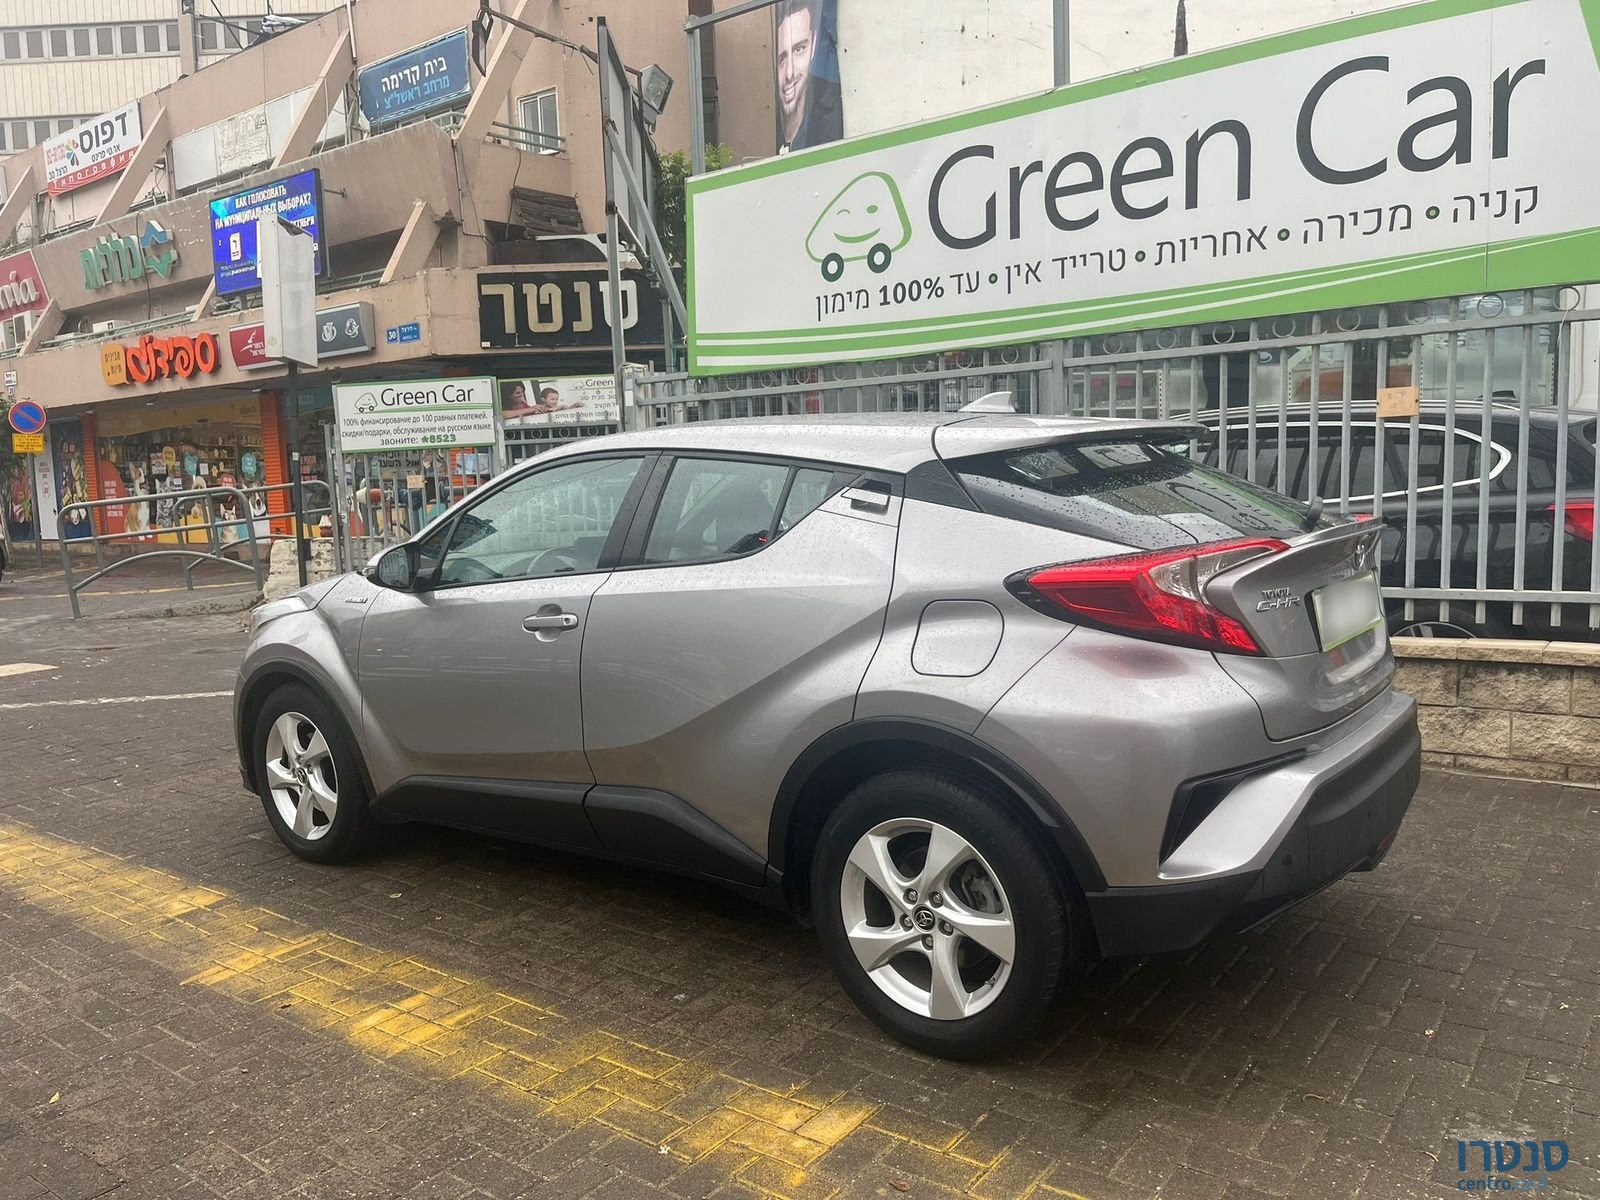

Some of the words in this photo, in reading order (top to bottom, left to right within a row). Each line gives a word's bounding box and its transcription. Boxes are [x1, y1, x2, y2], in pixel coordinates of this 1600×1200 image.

[381, 65, 420, 93] קדימה
[424, 57, 447, 77] בית
[423, 75, 450, 95] מרחב
[79, 112, 127, 154] דפוס
[927, 118, 1252, 251] Green
[1295, 55, 1546, 185] Car
[235, 195, 248, 209] КАК
[248, 185, 287, 204] ГОЛОСОВАТЬ
[1452, 185, 1538, 225] קניה
[215, 218, 224, 230] НА
[277, 192, 312, 213] ВЫБОРАХ?
[1303, 203, 1413, 244] מכירה
[1154, 225, 1268, 266] אחריות
[1052, 247, 1126, 280] טרייד
[950, 270, 980, 294] עד
[1004, 259, 1042, 294] אין
[878, 275, 945, 307] 100%
[815, 287, 870, 321] מימון
[388, 330, 397, 341] 30
[380, 388, 438, 406] Green
[442, 384, 474, 403] Car
[585, 379, 614, 387] Green
[343, 417, 359, 427] 100%
[360, 415, 411, 426] финансирование
[412, 415, 421, 424] до
[422, 414, 433, 423] 100
[433, 413, 456, 423] равных
[392, 425, 437, 437] обслуживание
[447, 424, 472, 434] русском
[380, 437, 419, 446] звоните:
[1256, 596, 1300, 613] C-HR
[1262, 587, 1290, 599] TOYOTA
